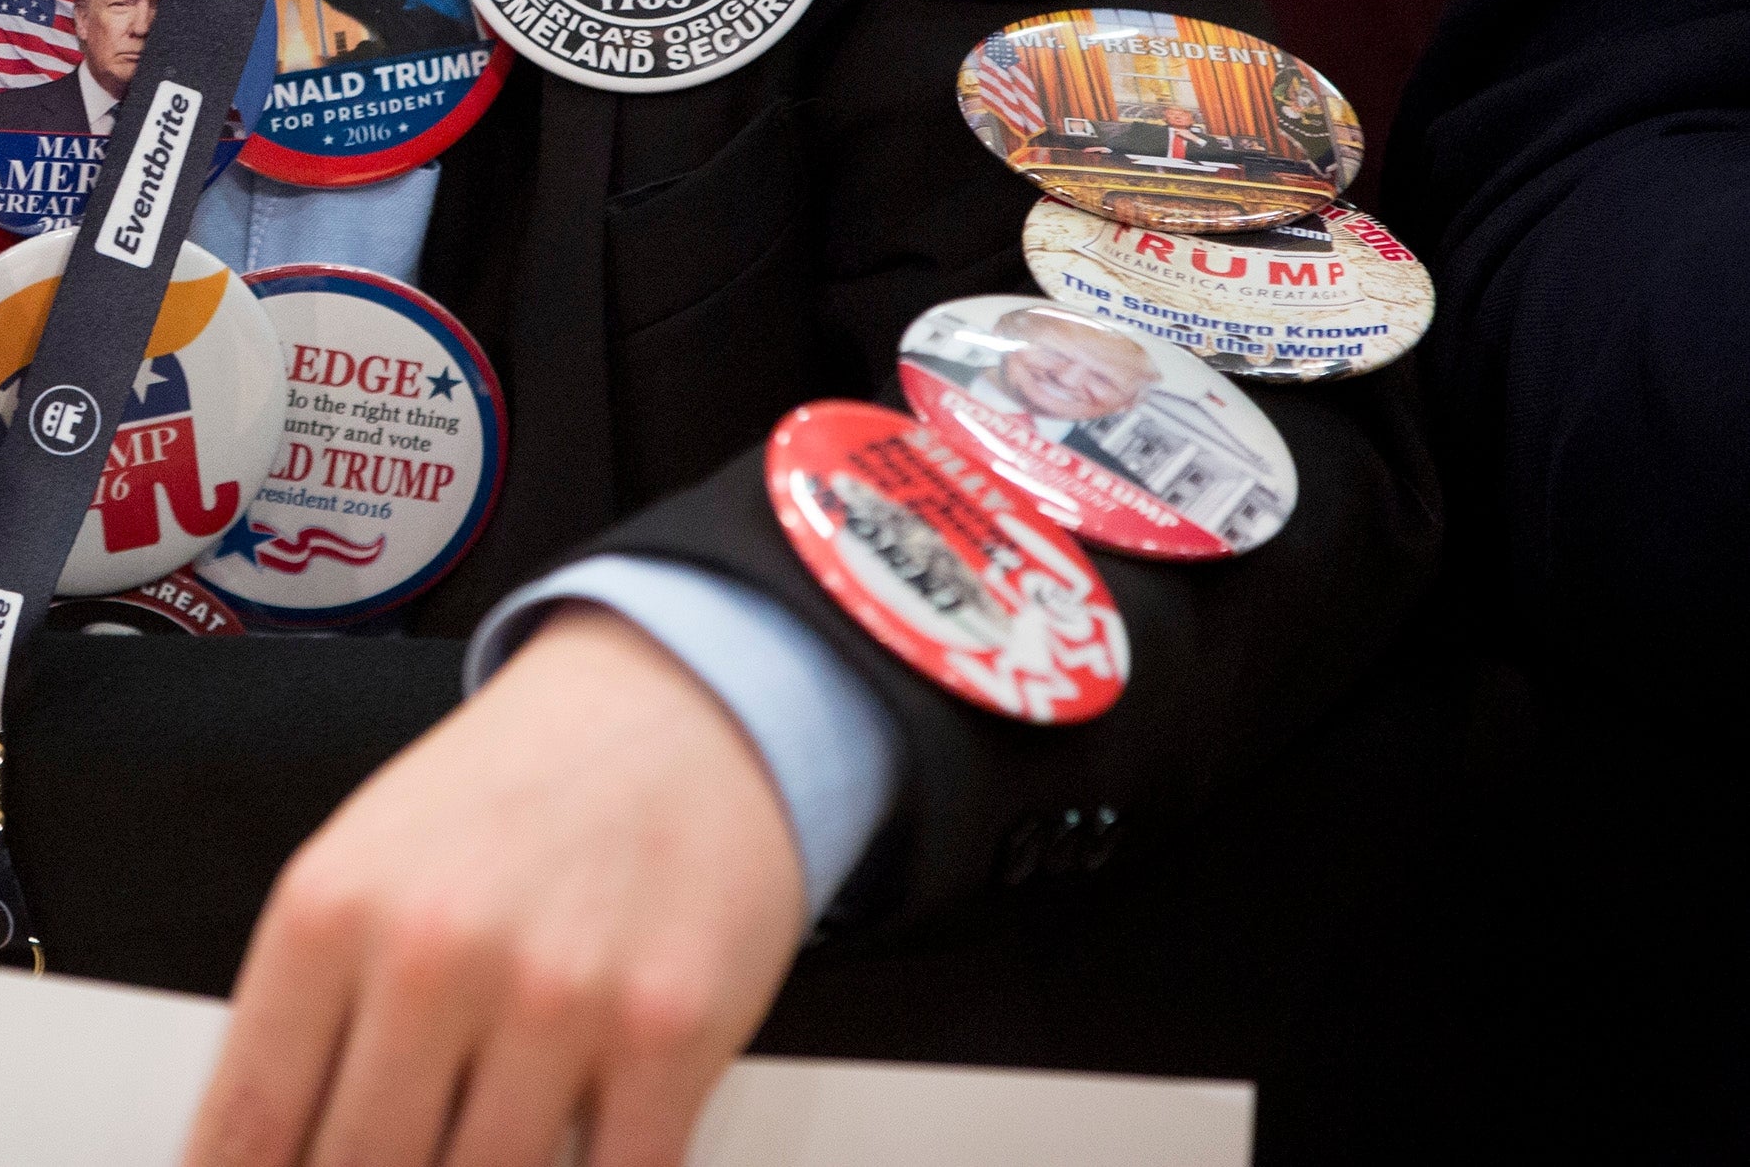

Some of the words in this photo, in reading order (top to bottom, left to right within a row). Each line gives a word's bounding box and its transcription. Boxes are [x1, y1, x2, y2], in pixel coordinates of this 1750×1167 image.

[1013, 32, 1064, 51] Mr.
[1079, 34, 1286, 69] PRESIDENT!
[262, 71, 366, 112] NALD
[373, 49, 490, 92] TRUMP
[271, 112, 315, 133] FOR
[323, 89, 447, 124] PRESIDENT
[34, 135, 110, 161] MAK
[343, 121, 392, 147] 2016
[113, 93, 190, 256] Eventbrite
[1344, 218, 1418, 263] 2016
[1134, 257, 1229, 294] AMERICA
[1239, 286, 1306, 301] GREAT
[1061, 271, 1112, 302] The
[1122, 293, 1275, 338] Sombrero
[1285, 323, 1389, 340] Known
[1215, 336, 1266, 356] the
[1277, 342, 1364, 360] World
[287, 344, 424, 399] EDGE
[284, 418, 340, 442] untry
[344, 423, 384, 447] and
[388, 428, 432, 453] vote
[314, 393, 346, 415] the
[351, 402, 402, 426] right
[405, 409, 461, 436] thing
[90, 471, 130, 506] 16
[322, 447, 455, 504] TRUMP
[1076, 463, 1180, 528] TRUMP
[255, 486, 338, 513] resident
[342, 498, 393, 521] 2016
[141, 582, 227, 633] REAT
